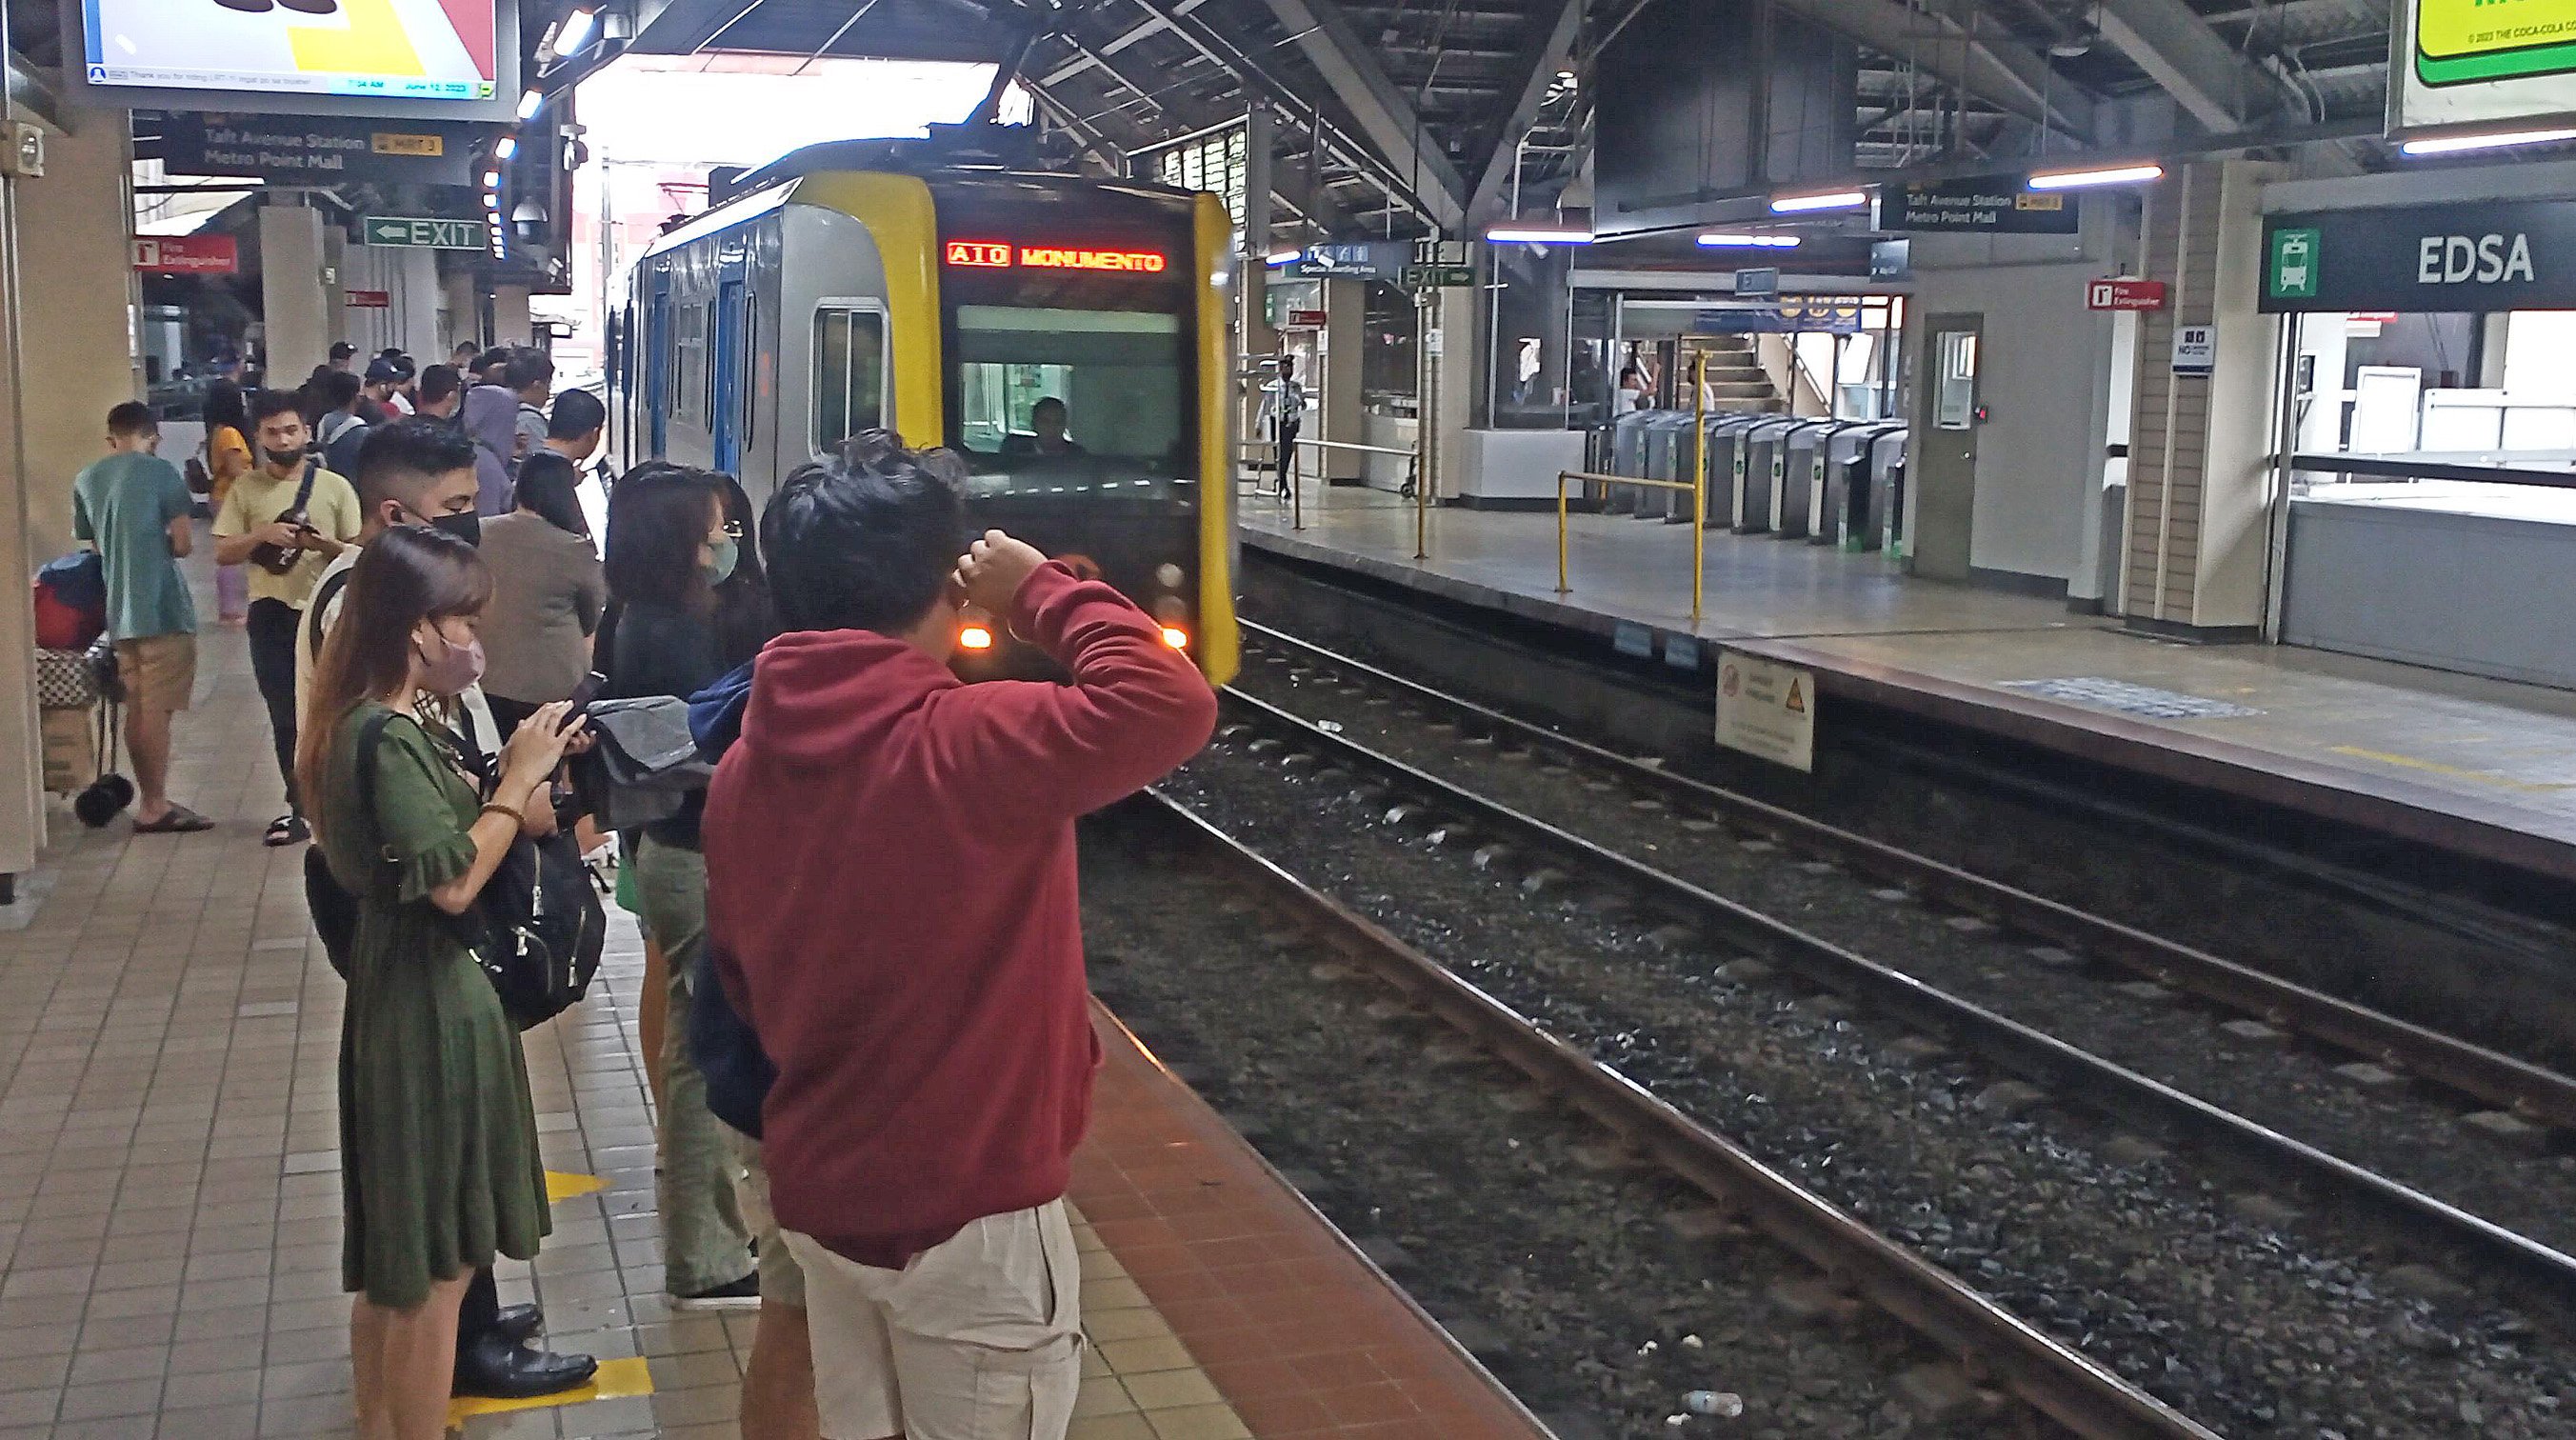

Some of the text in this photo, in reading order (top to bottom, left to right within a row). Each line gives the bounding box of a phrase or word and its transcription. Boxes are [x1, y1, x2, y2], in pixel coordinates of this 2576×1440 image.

[2496, 29, 2510, 40] THE
[2513, 21, 2564, 38] COCA-COLA
[205, 129, 365, 150] Taft Avenue Station
[204, 150, 345, 170] Metro Point Mall
[1907, 193, 2012, 207] Taft Avenue Station
[1907, 210, 1997, 223] Metro Point Mall
[410, 222, 475, 246] EXIT
[951, 246, 1165, 271] A10 MONUMENTO
[2418, 232, 2535, 284] EDSA
[1407, 268, 1445, 285] EXIT
